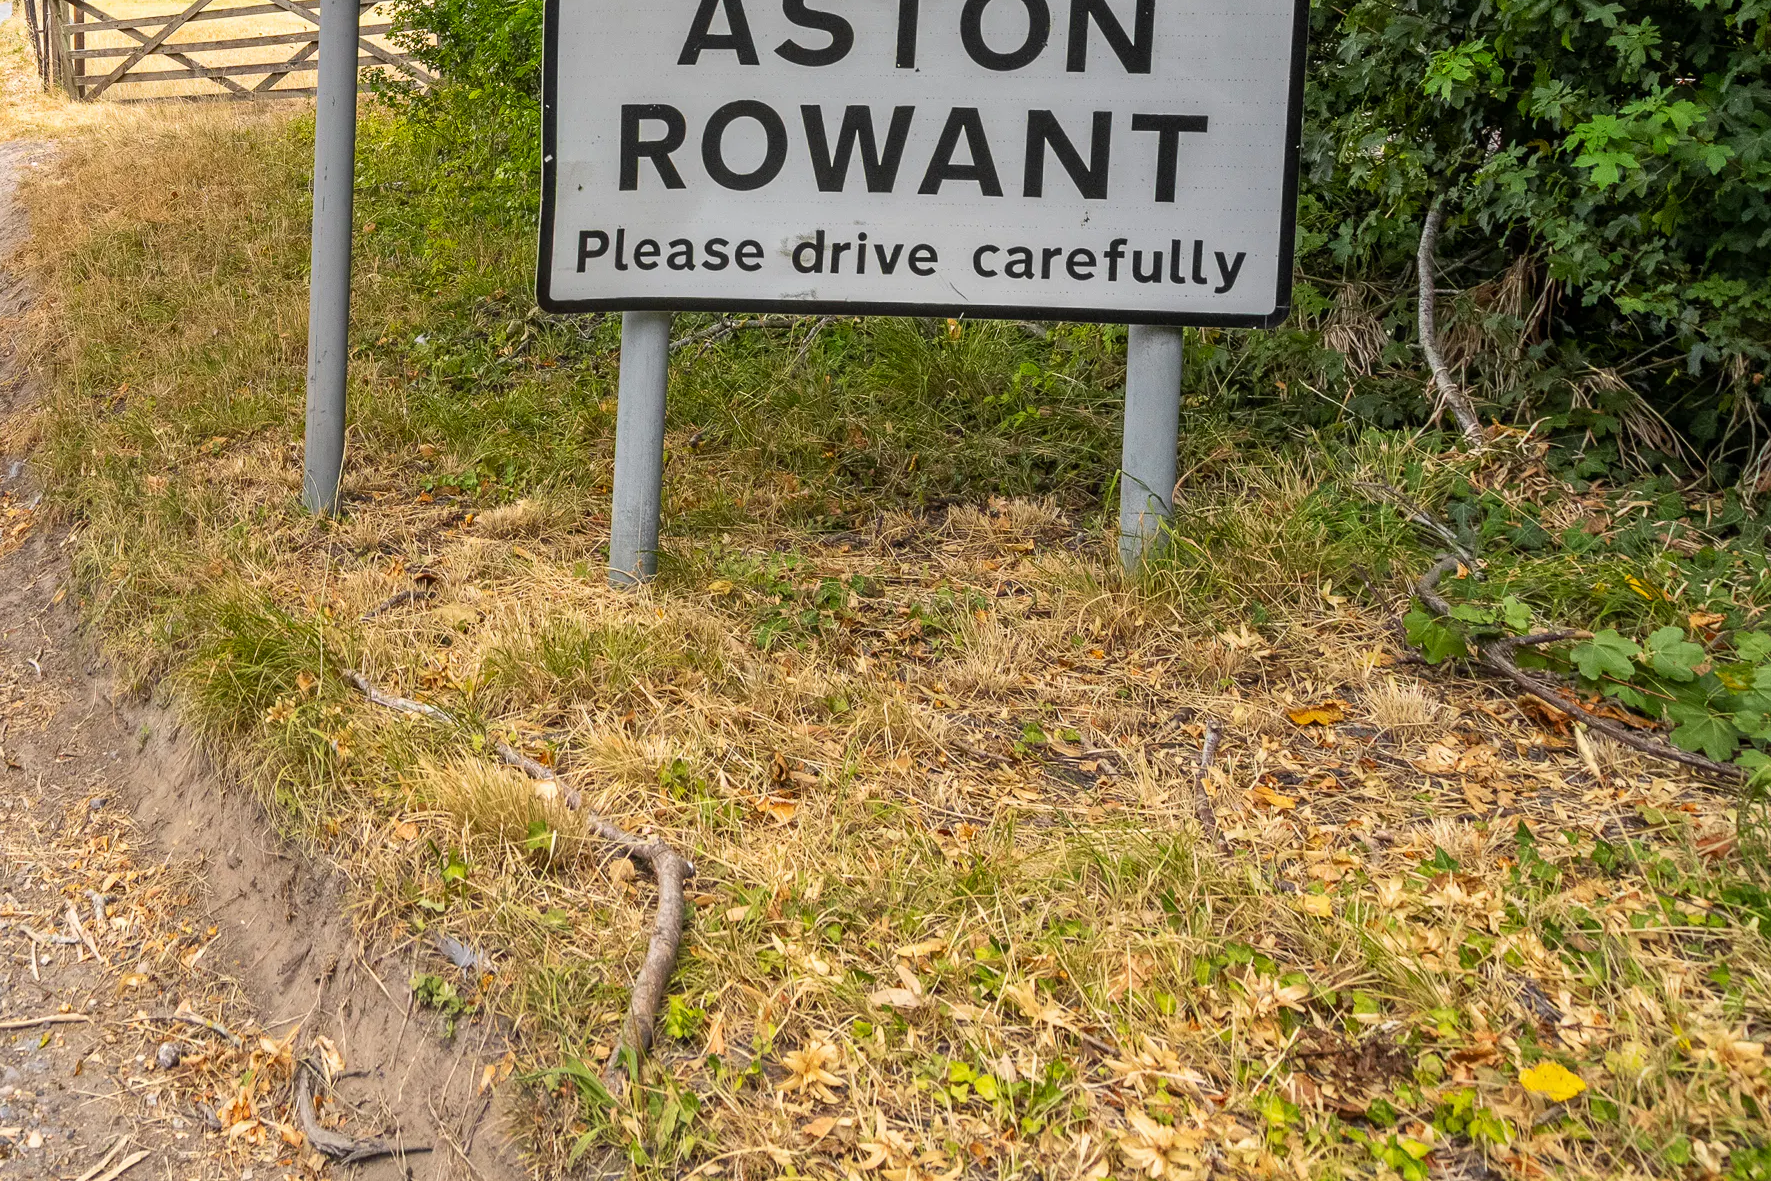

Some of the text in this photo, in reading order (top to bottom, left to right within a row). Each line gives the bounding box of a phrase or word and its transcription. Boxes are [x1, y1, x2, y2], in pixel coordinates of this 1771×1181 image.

[618, 99, 1209, 203] ROWANT
[576, 229, 1246, 294] Please drive carefully
